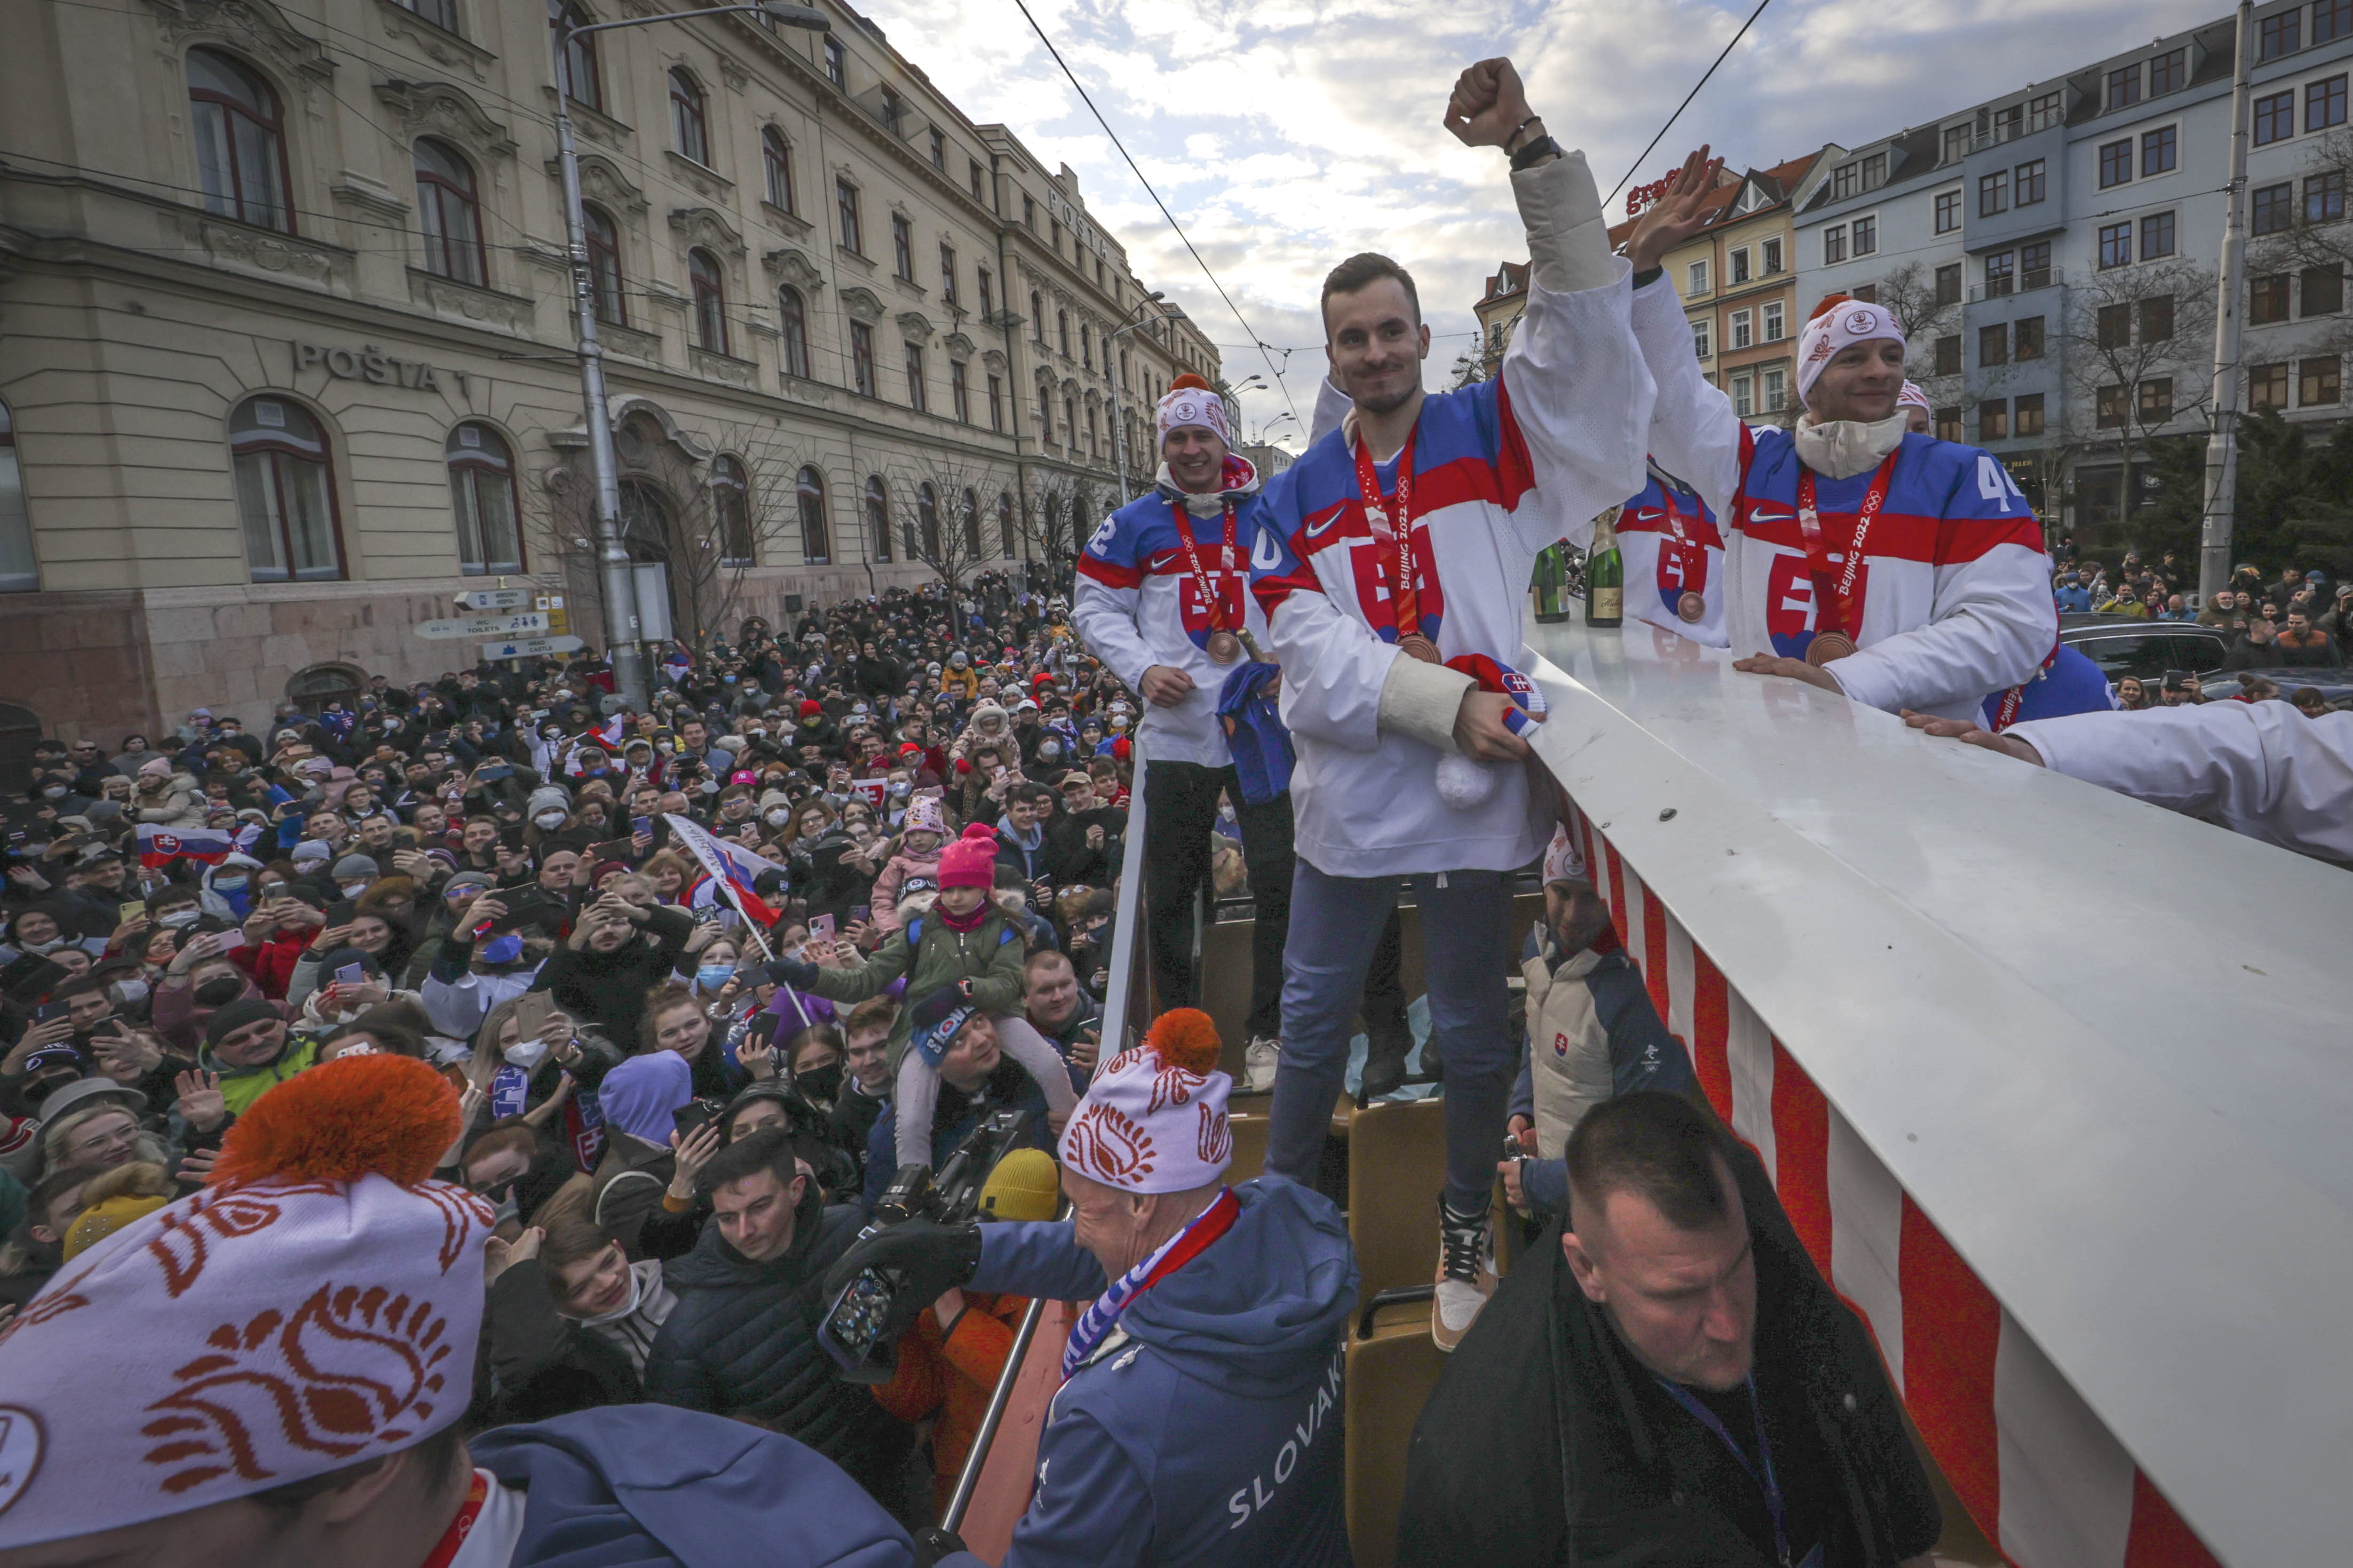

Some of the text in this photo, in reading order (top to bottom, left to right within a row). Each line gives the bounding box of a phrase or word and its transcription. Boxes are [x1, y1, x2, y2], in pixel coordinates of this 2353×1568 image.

[293, 340, 471, 399] POŠTA 1
[1088, 513, 1117, 556] 2
[1399, 505, 1412, 590] BEIJING 2022
[1839, 516, 1872, 596] BEIJING 2022
[1190, 552, 1213, 604] BEIJING 2022
[2001, 687, 2019, 722] BEIJING
